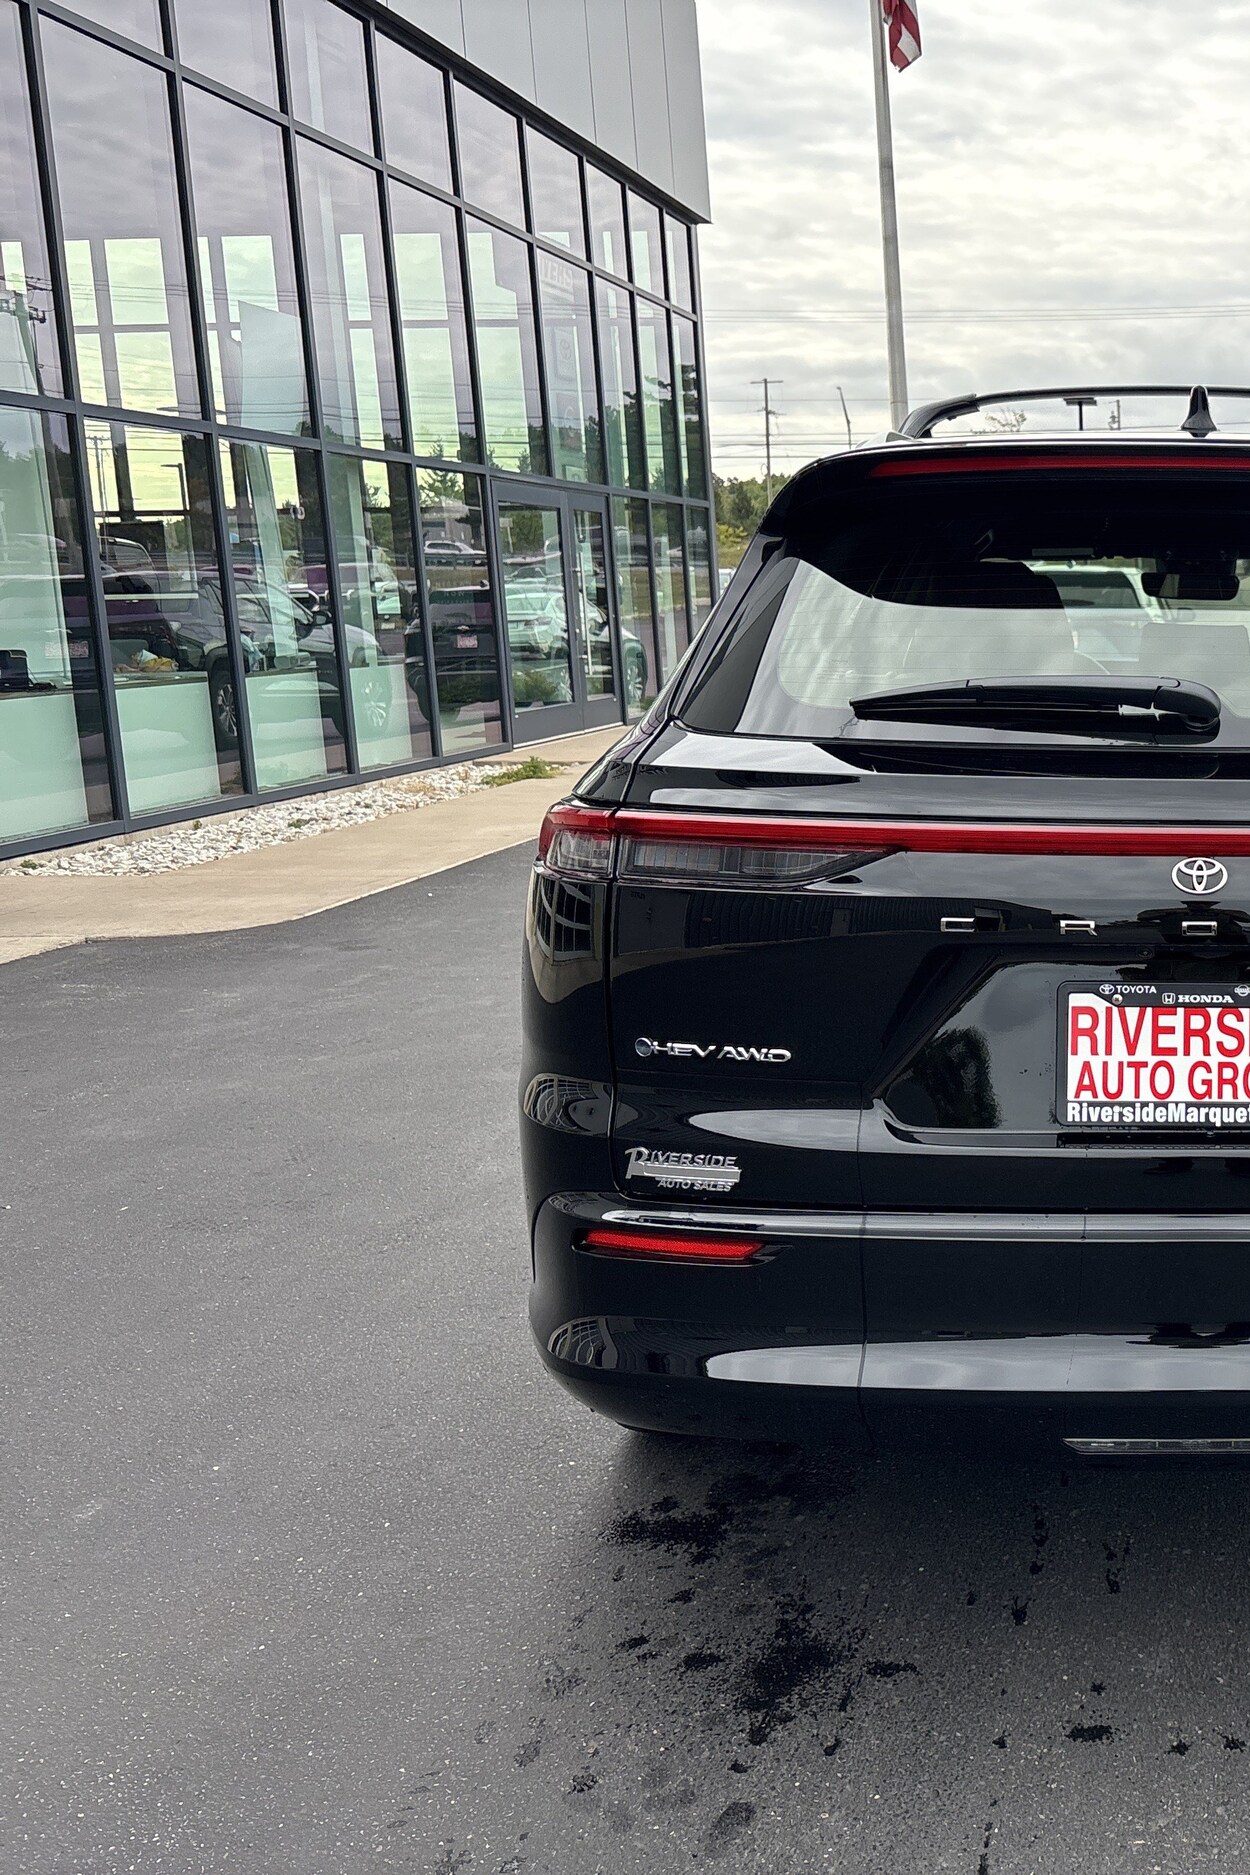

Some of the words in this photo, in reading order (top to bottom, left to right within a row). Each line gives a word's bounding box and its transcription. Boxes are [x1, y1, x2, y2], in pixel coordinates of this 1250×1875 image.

[1116, 985, 1157, 994] TOYOTA
[1178, 994, 1234, 1004] HONDA
[717, 1046, 792, 1063] AWD
[1074, 1060, 1175, 1100] AUTO
[624, 1146, 740, 1179] RIVERSIDE
[656, 1177, 693, 1190] AUTO
[692, 1180, 734, 1193] SALES
